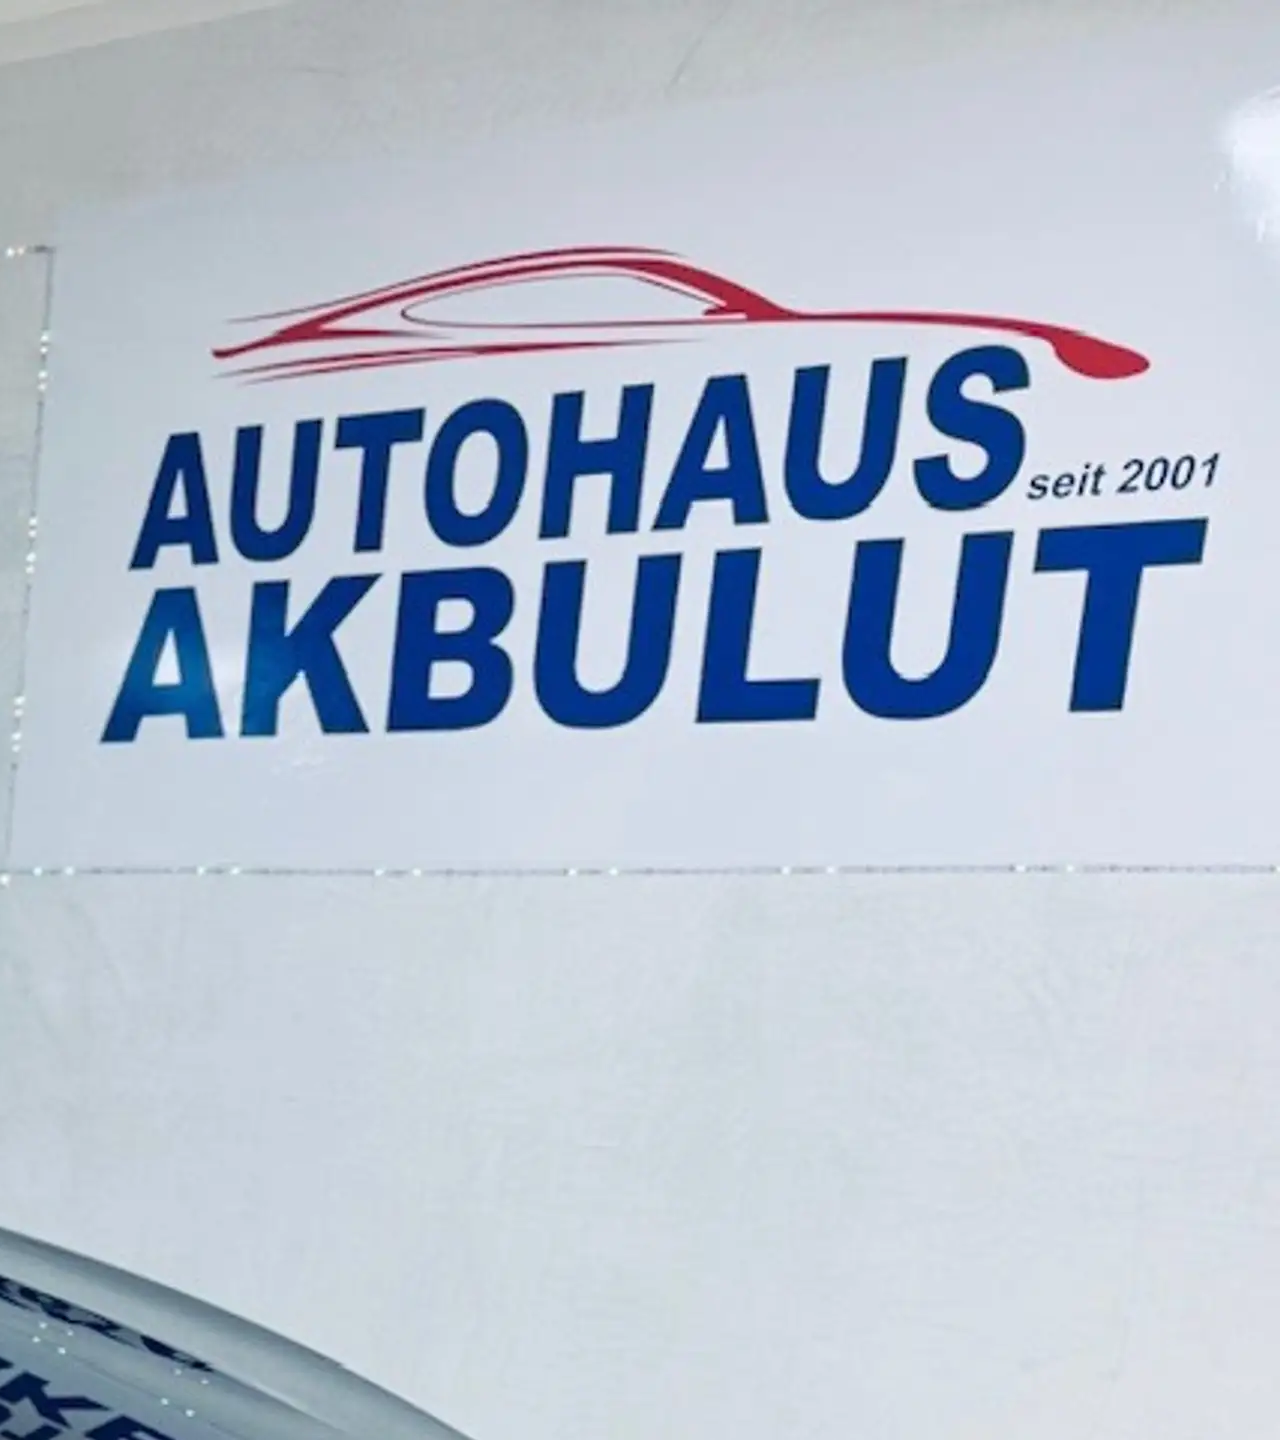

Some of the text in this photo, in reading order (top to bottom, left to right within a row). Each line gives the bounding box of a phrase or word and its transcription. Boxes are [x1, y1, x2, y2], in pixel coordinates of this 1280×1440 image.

[128, 344, 1031, 572] AUTOHAUS
[1025, 451, 1222, 502] seit 2001
[99, 516, 1210, 745] AKBULUT
